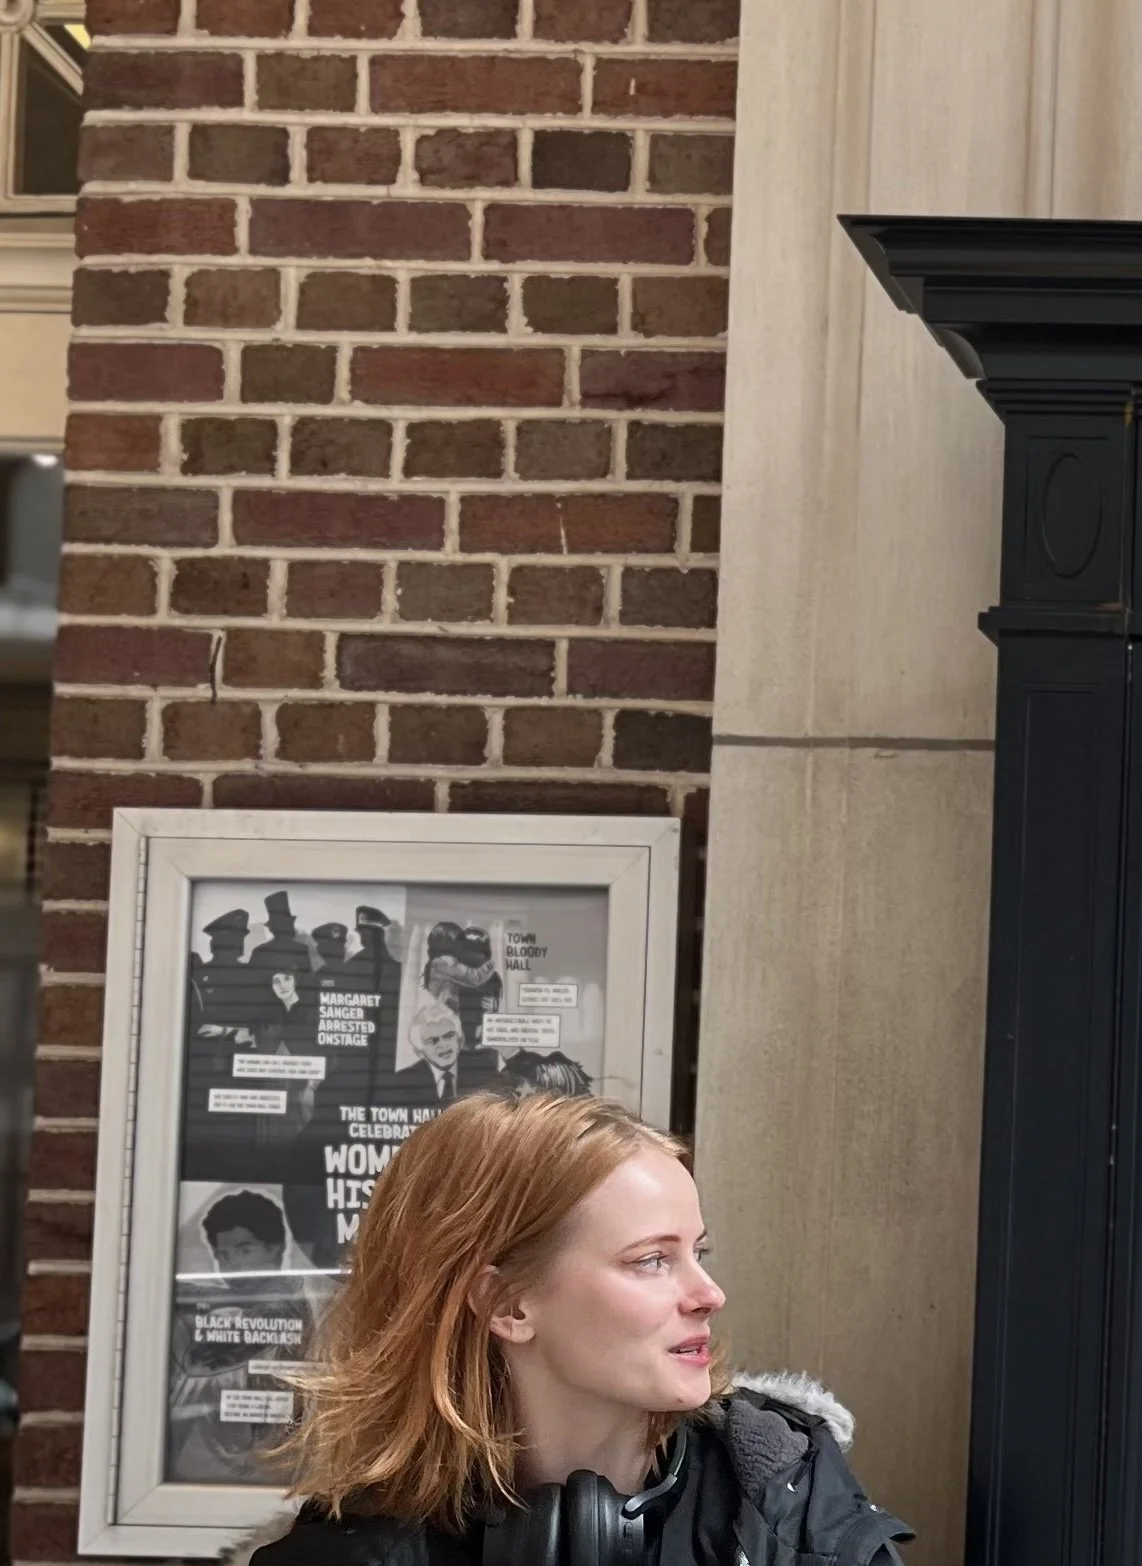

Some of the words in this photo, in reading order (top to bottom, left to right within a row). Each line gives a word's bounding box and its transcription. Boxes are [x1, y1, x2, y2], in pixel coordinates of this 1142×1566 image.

[506, 933, 537, 945] TOWN
[506, 945, 548, 958] BLOODY
[505, 959, 532, 971] HALL
[319, 992, 382, 1007] MARGARET
[318, 1006, 364, 1019] SANGER
[317, 1020, 376, 1034] ARRESTED
[317, 1032, 368, 1046] ONSTAGE
[340, 1106, 366, 1121] THE
[370, 1107, 409, 1123] TOWN
[194, 1315, 232, 1329] BLACK
[234, 1317, 303, 1331] REVOLUTION
[206, 1330, 241, 1343] WHITE
[243, 1331, 302, 1345] BACKLASH
